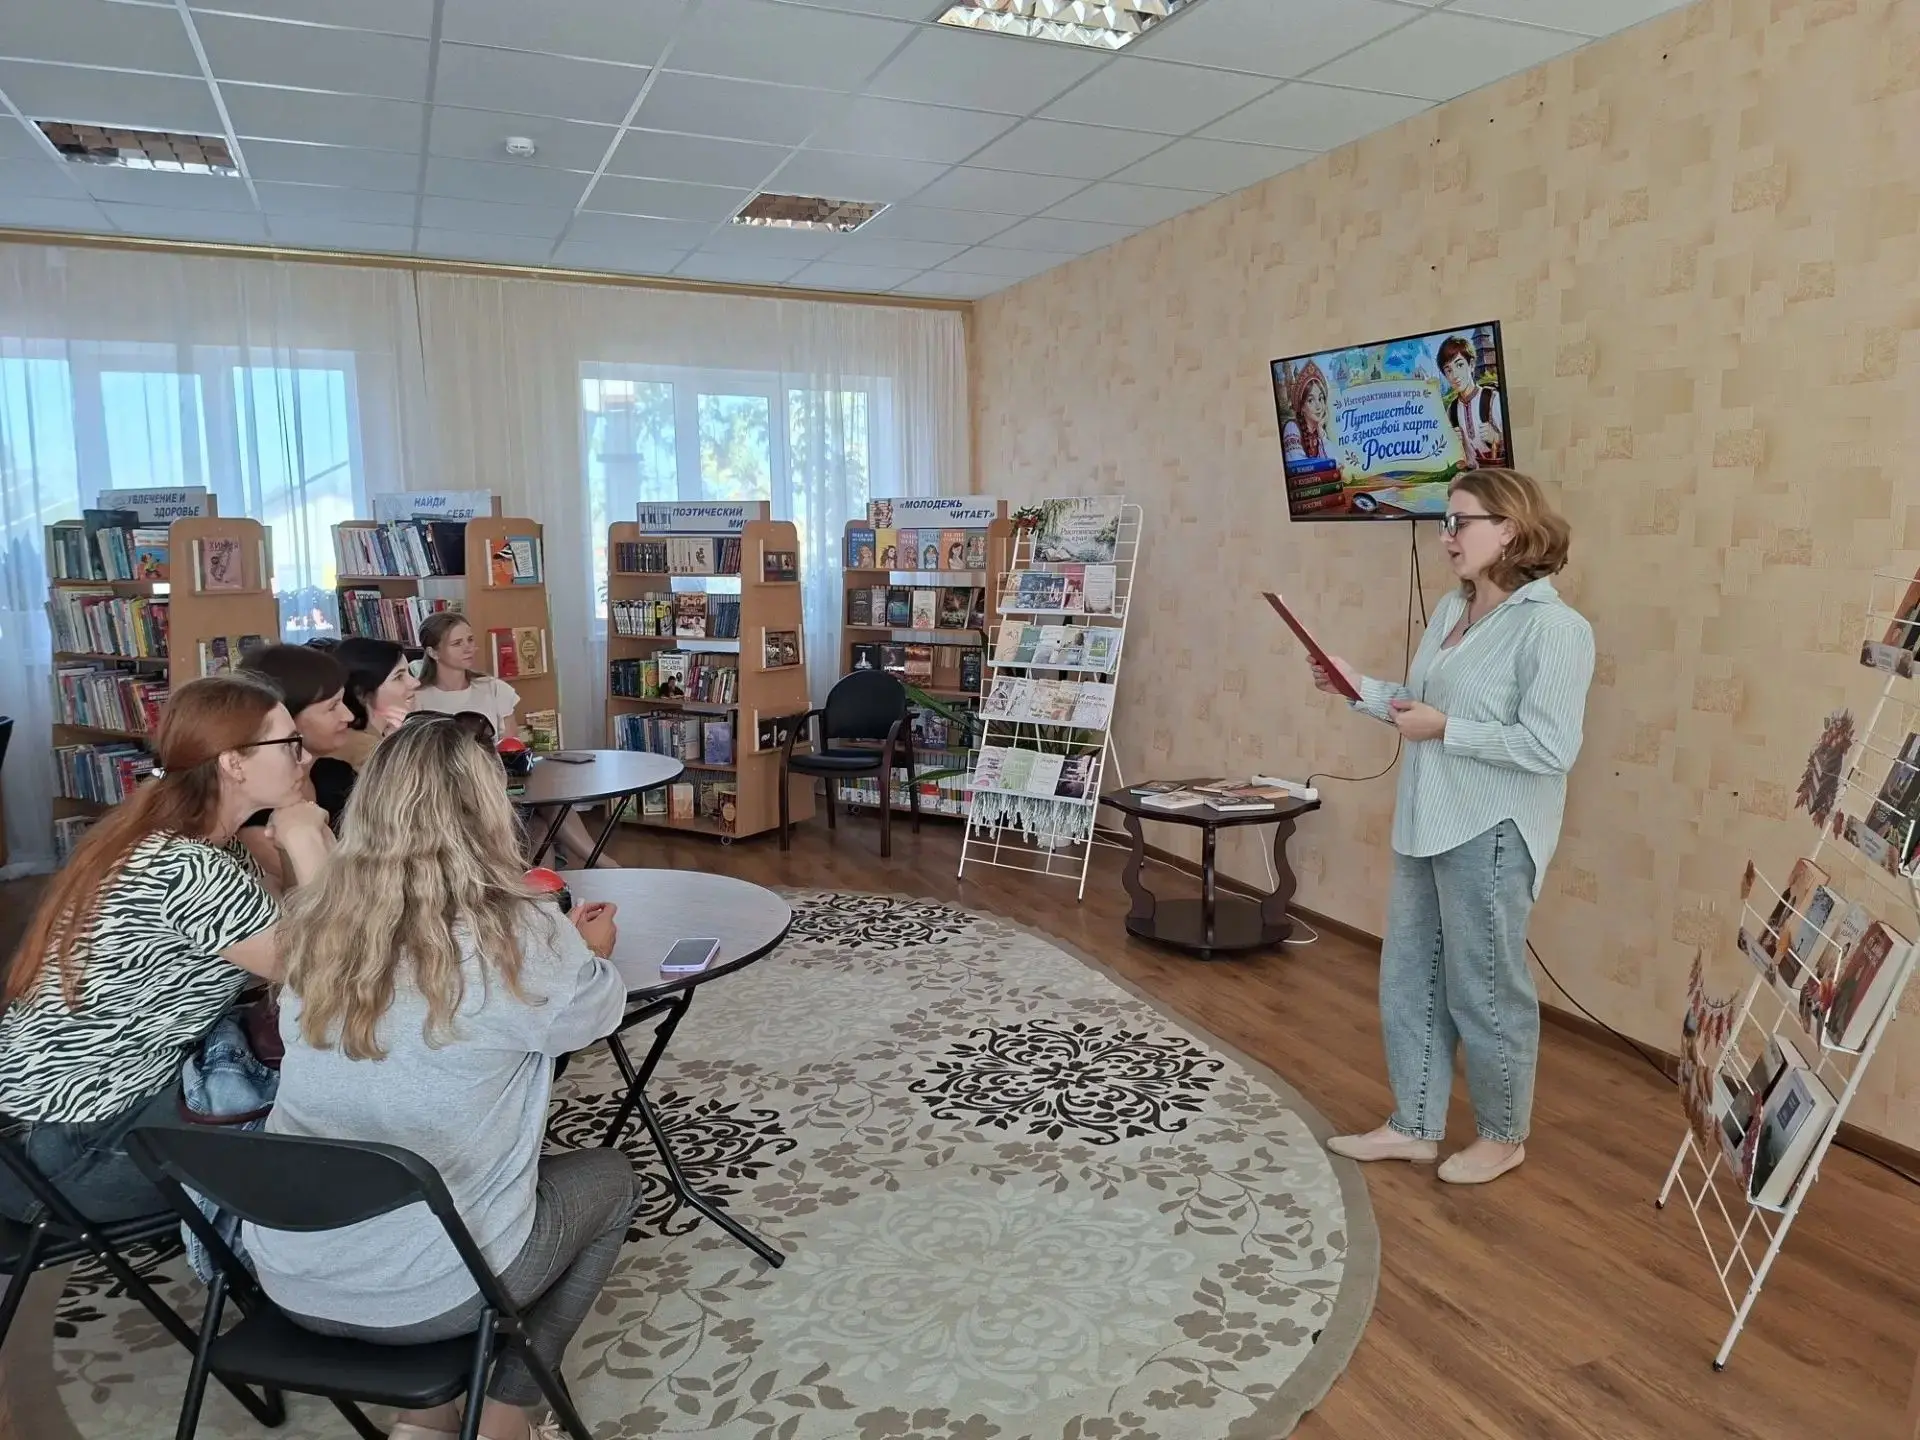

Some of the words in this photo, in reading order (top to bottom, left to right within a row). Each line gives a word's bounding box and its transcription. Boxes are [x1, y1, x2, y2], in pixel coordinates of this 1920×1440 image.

[1344, 391, 1401, 406] Интерактивная
[1403, 389, 1421, 400] игра
[1338, 435, 1350, 446] по
[1352, 421, 1400, 445] языковой
[1403, 419, 1439, 435] карте
[178, 492, 186, 503] И
[414, 495, 446, 508] НАЙДИ
[154, 506, 200, 517] ЗДОРОВЬЕ
[447, 508, 474, 519] СЕБЯ!
[728, 519, 747, 528] МИ
